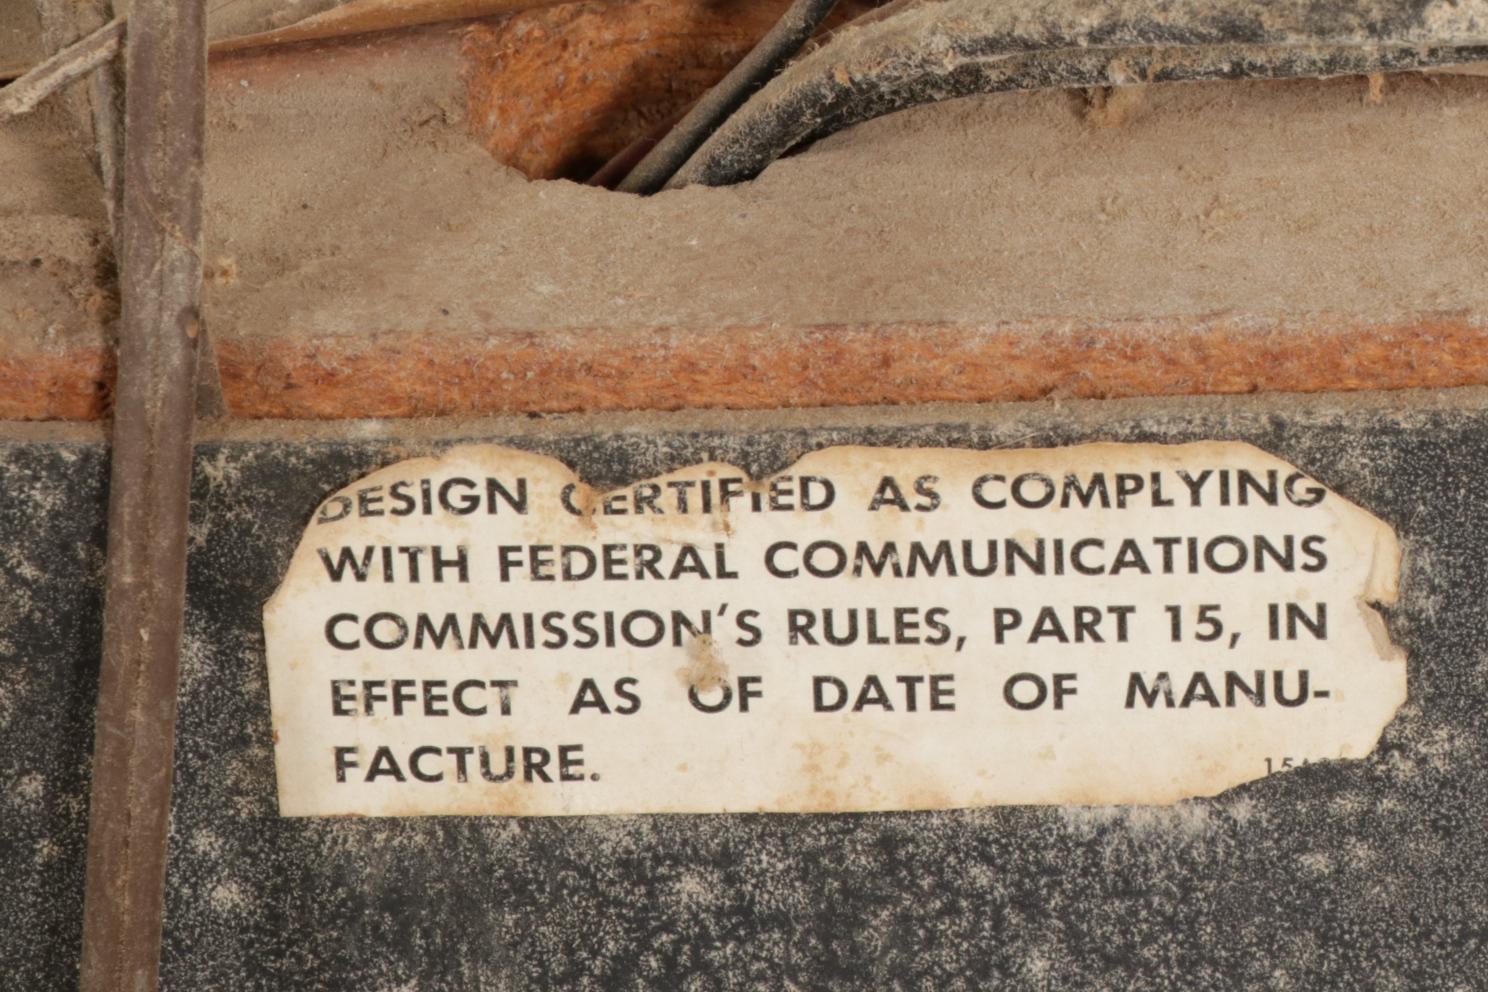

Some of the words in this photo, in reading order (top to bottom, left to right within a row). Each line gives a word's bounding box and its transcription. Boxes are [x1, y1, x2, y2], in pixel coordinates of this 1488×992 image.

[315, 475, 530, 524] DESIGN
[868, 474, 942, 513] AS
[971, 468, 1328, 511] COMPLYING
[315, 543, 471, 583] WITH
[499, 542, 739, 583] FEDERAL
[763, 534, 1329, 580] COMMUNICATIONS
[324, 603, 763, 651] COMMISSION'S
[788, 606, 968, 653] RULES,
[993, 604, 1137, 646] PART
[1164, 603, 1243, 650] 15,
[1268, 601, 1329, 642] IN
[330, 678, 520, 718] EFFECT
[568, 676, 643, 716] AS
[687, 675, 763, 714] OF
[811, 673, 957, 714] DATE
[1002, 672, 1080, 712] OF
[1123, 669, 1332, 710] MANU-
[333, 743, 602, 784] FACTURE.
